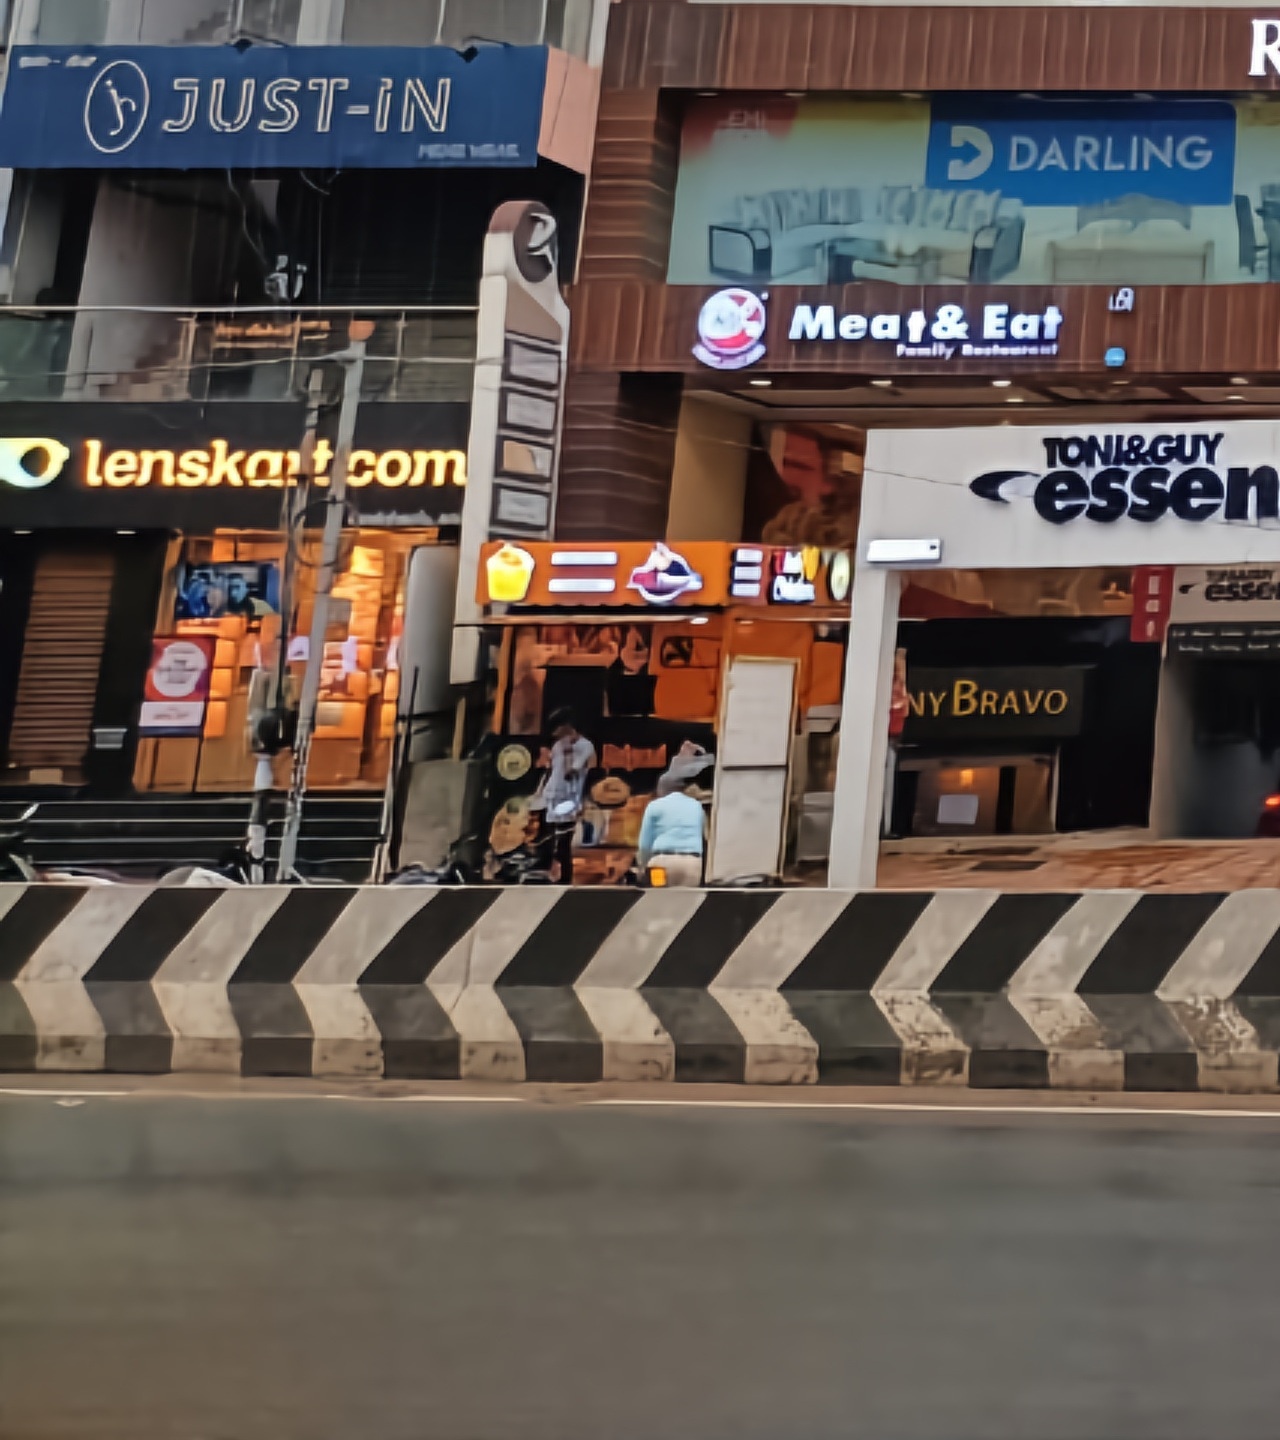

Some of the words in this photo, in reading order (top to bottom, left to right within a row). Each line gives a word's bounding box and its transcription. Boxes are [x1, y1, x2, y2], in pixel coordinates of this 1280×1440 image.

[1008, 135, 1213, 172] DARLING
[982, 303, 1063, 341] Eat
[83, 438, 469, 488] lenskartcom
[1042, 433, 1225, 469] TONI&GUY
[907, 690, 948, 717] NY
[951, 679, 1069, 717] BRAVO
